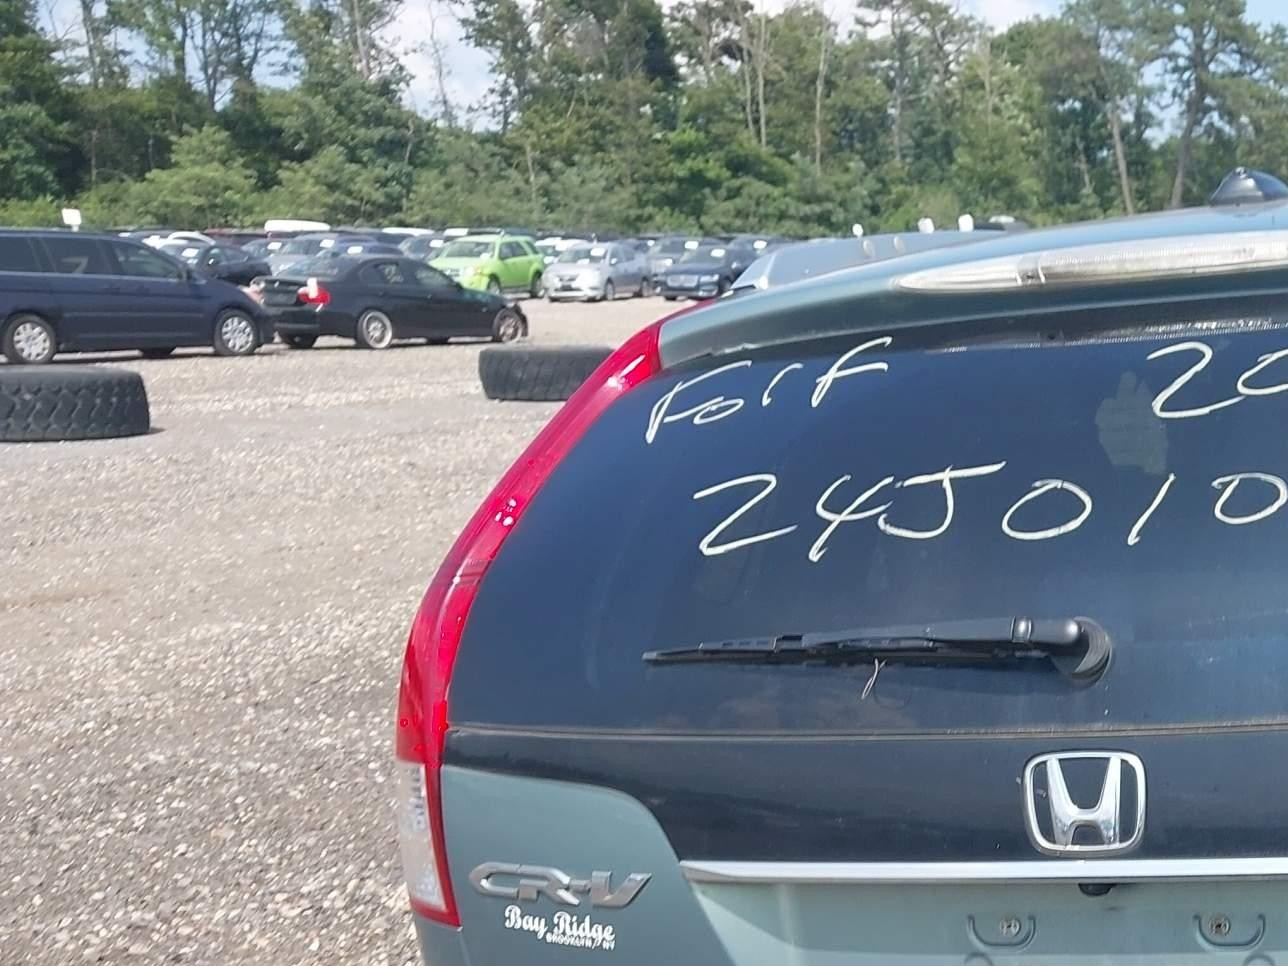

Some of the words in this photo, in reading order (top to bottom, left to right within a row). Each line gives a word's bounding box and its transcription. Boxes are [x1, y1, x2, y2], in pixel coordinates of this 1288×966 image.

[468, 860, 653, 908] CR-V
[504, 904, 548, 940] Bay
[553, 911, 616, 942] Ridge
